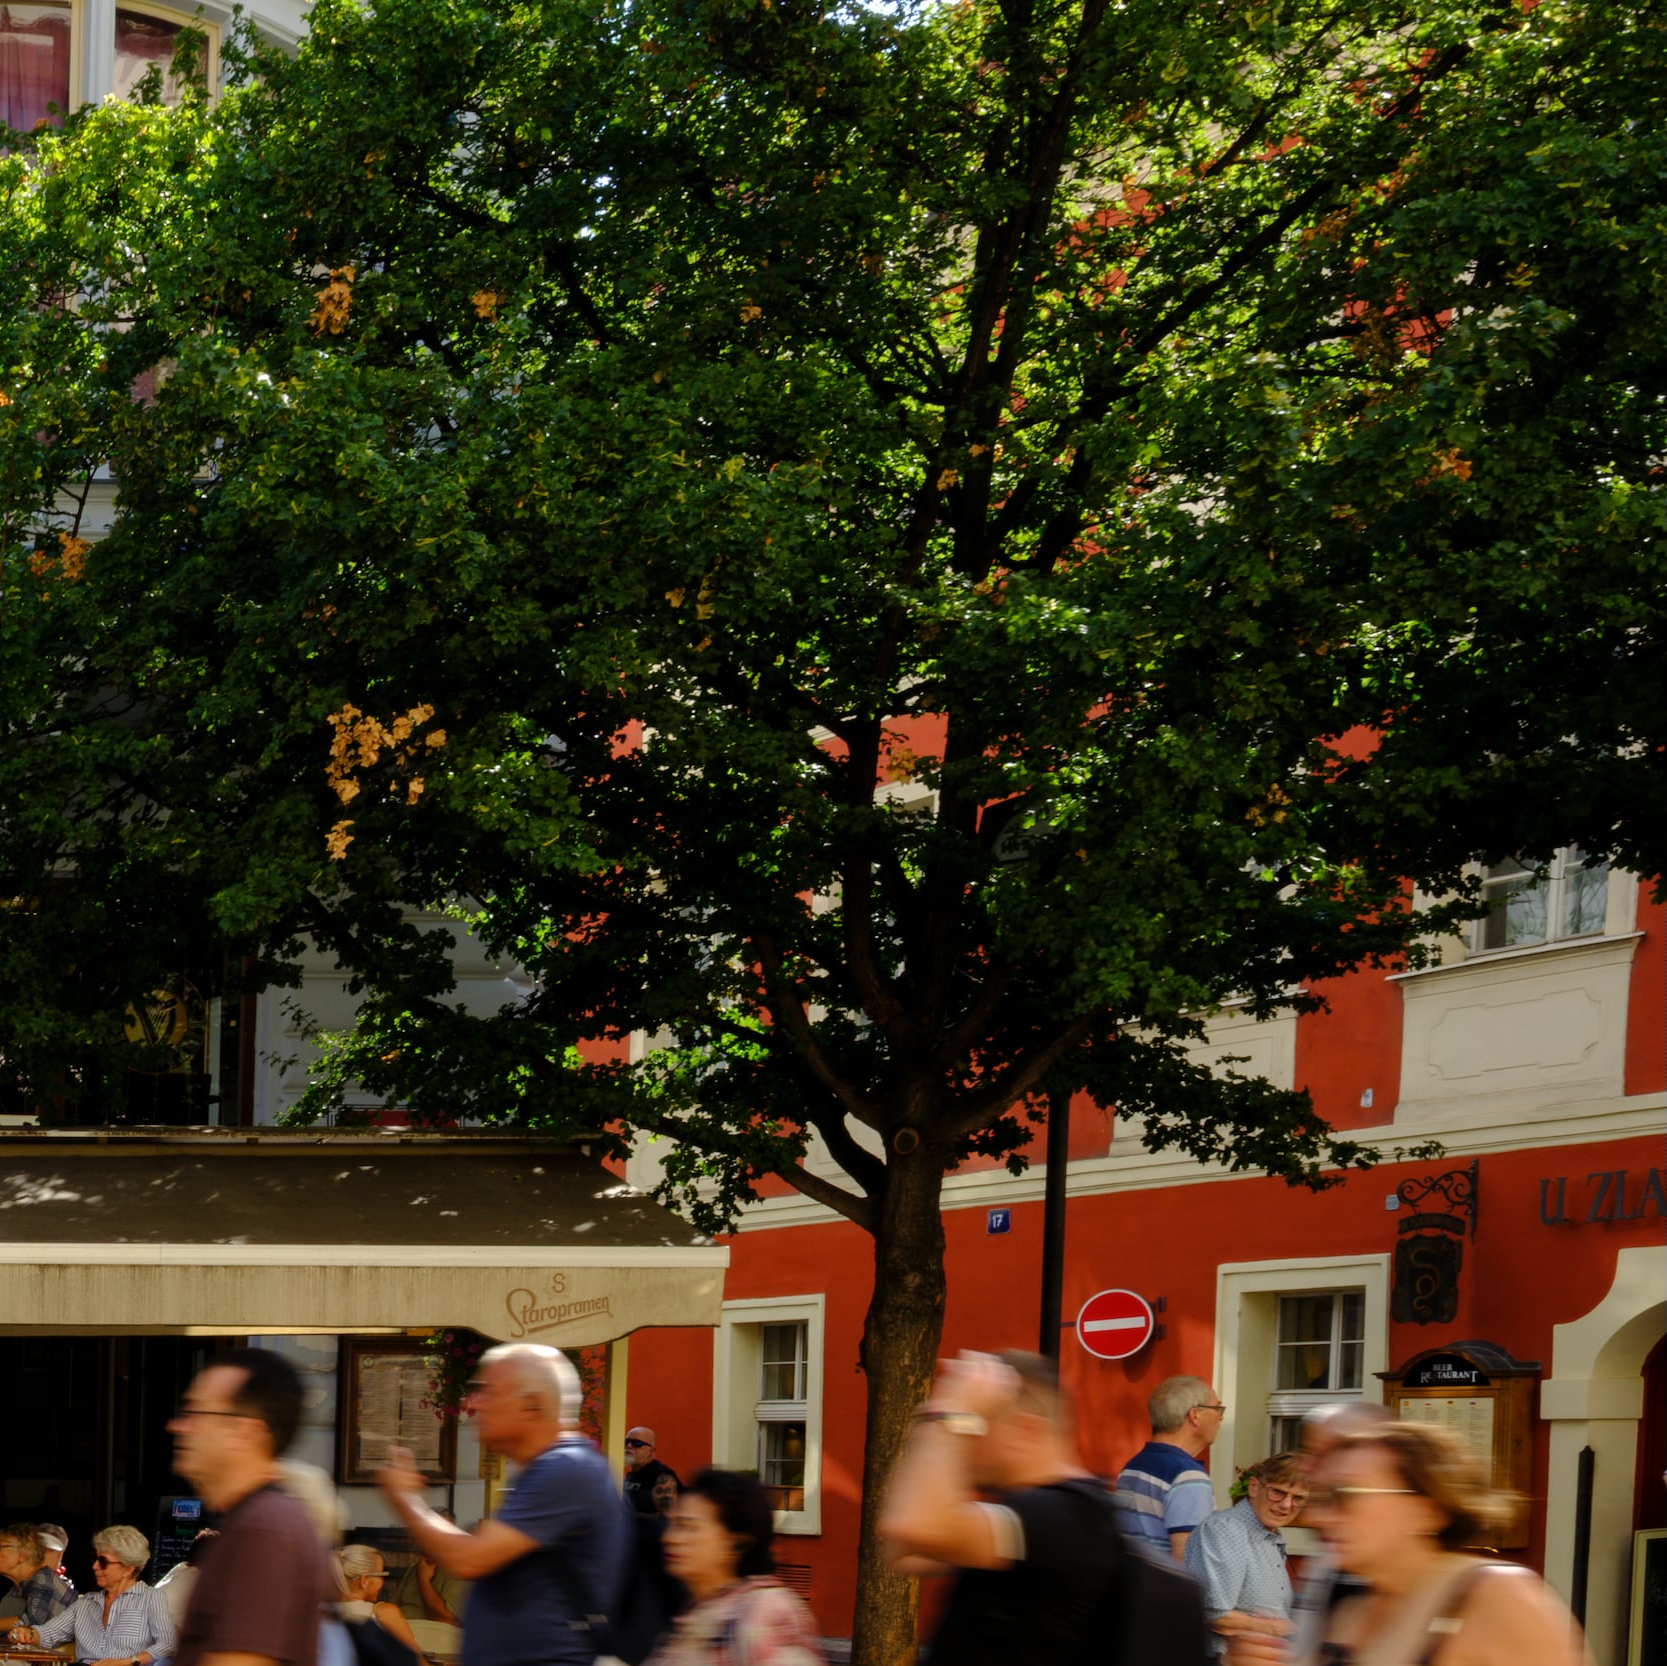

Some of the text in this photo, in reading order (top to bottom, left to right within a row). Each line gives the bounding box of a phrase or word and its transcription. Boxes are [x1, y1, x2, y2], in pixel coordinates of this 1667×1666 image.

[1586, 1167, 1667, 1222] ZLA
[992, 1213, 1004, 1229] 17
[505, 1288, 611, 1338] Staropramen
[1432, 1363, 1454, 1372] BEER
